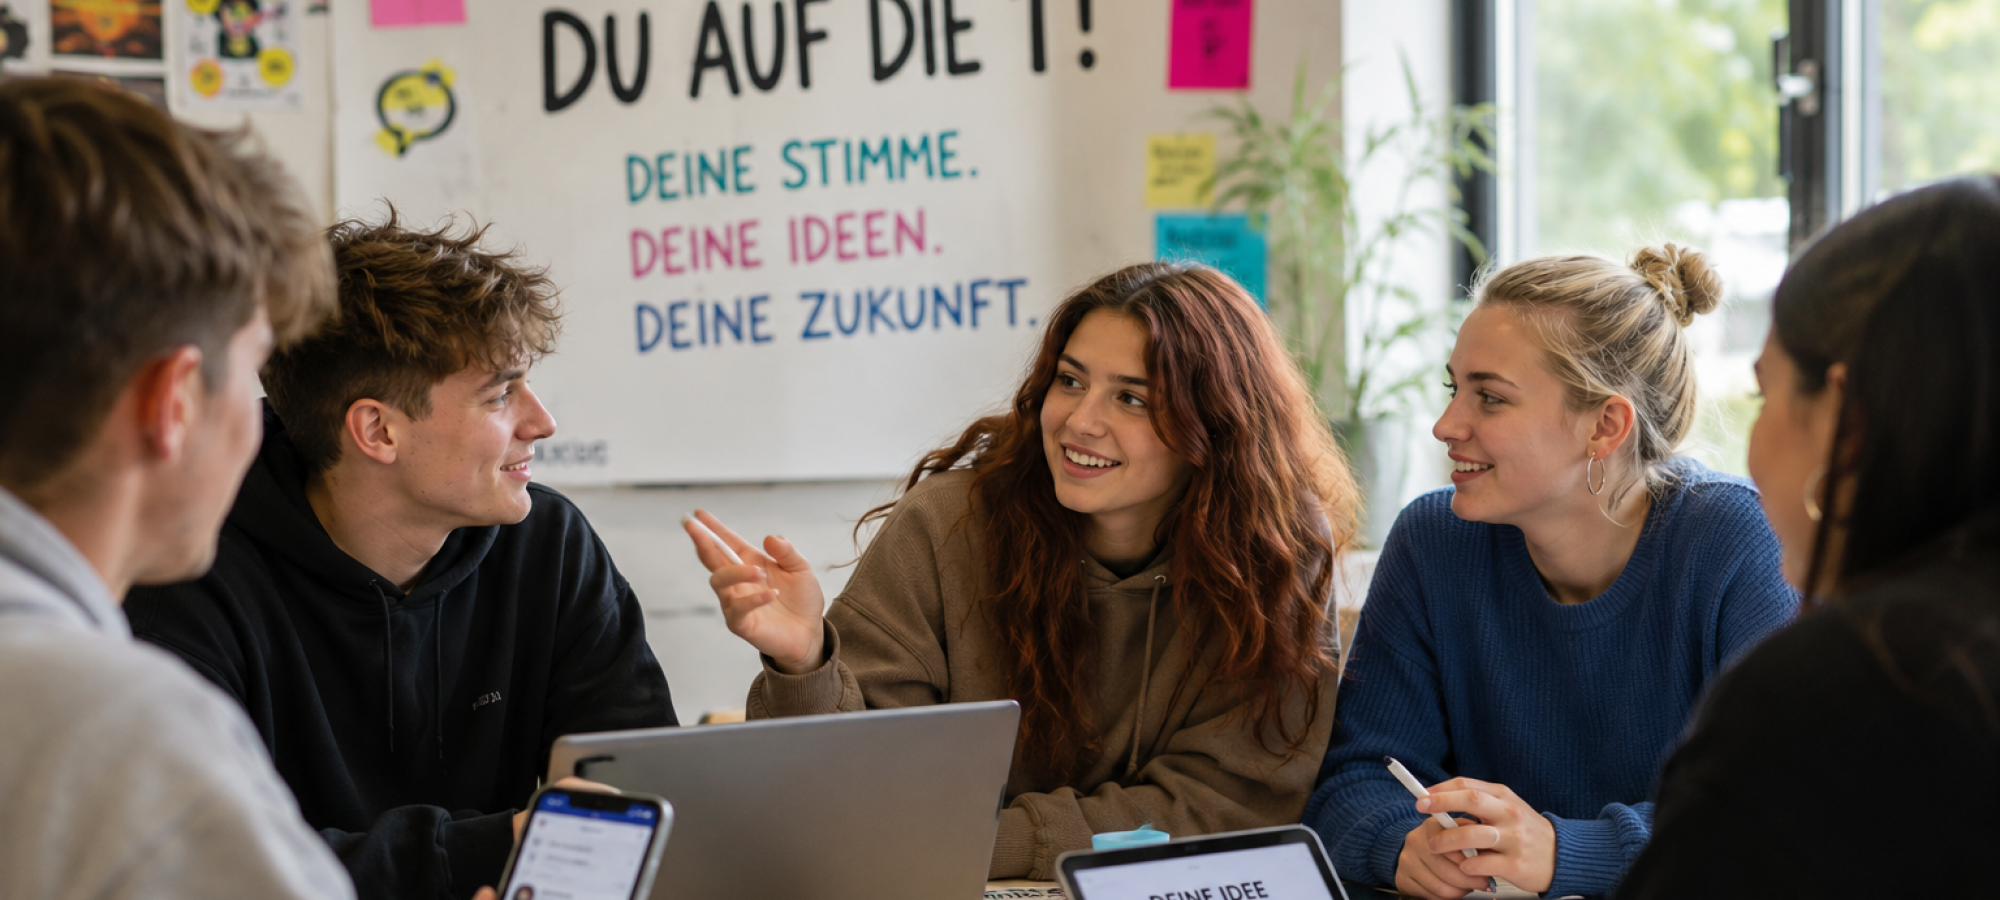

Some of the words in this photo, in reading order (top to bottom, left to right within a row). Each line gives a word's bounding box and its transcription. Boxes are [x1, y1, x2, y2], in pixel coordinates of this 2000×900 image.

[542, 9, 651, 113] DU
[689, 0, 829, 99] AUF
[868, 0, 982, 82] DIE
[625, 144, 756, 204] DEINE
[780, 130, 979, 191] STIMME.
[629, 220, 762, 280] DEINE
[788, 208, 943, 266] IDEEN.
[634, 295, 774, 354] DEINE
[798, 278, 1038, 341] ZUKUNFT.
[1149, 887, 1213, 900] INE
